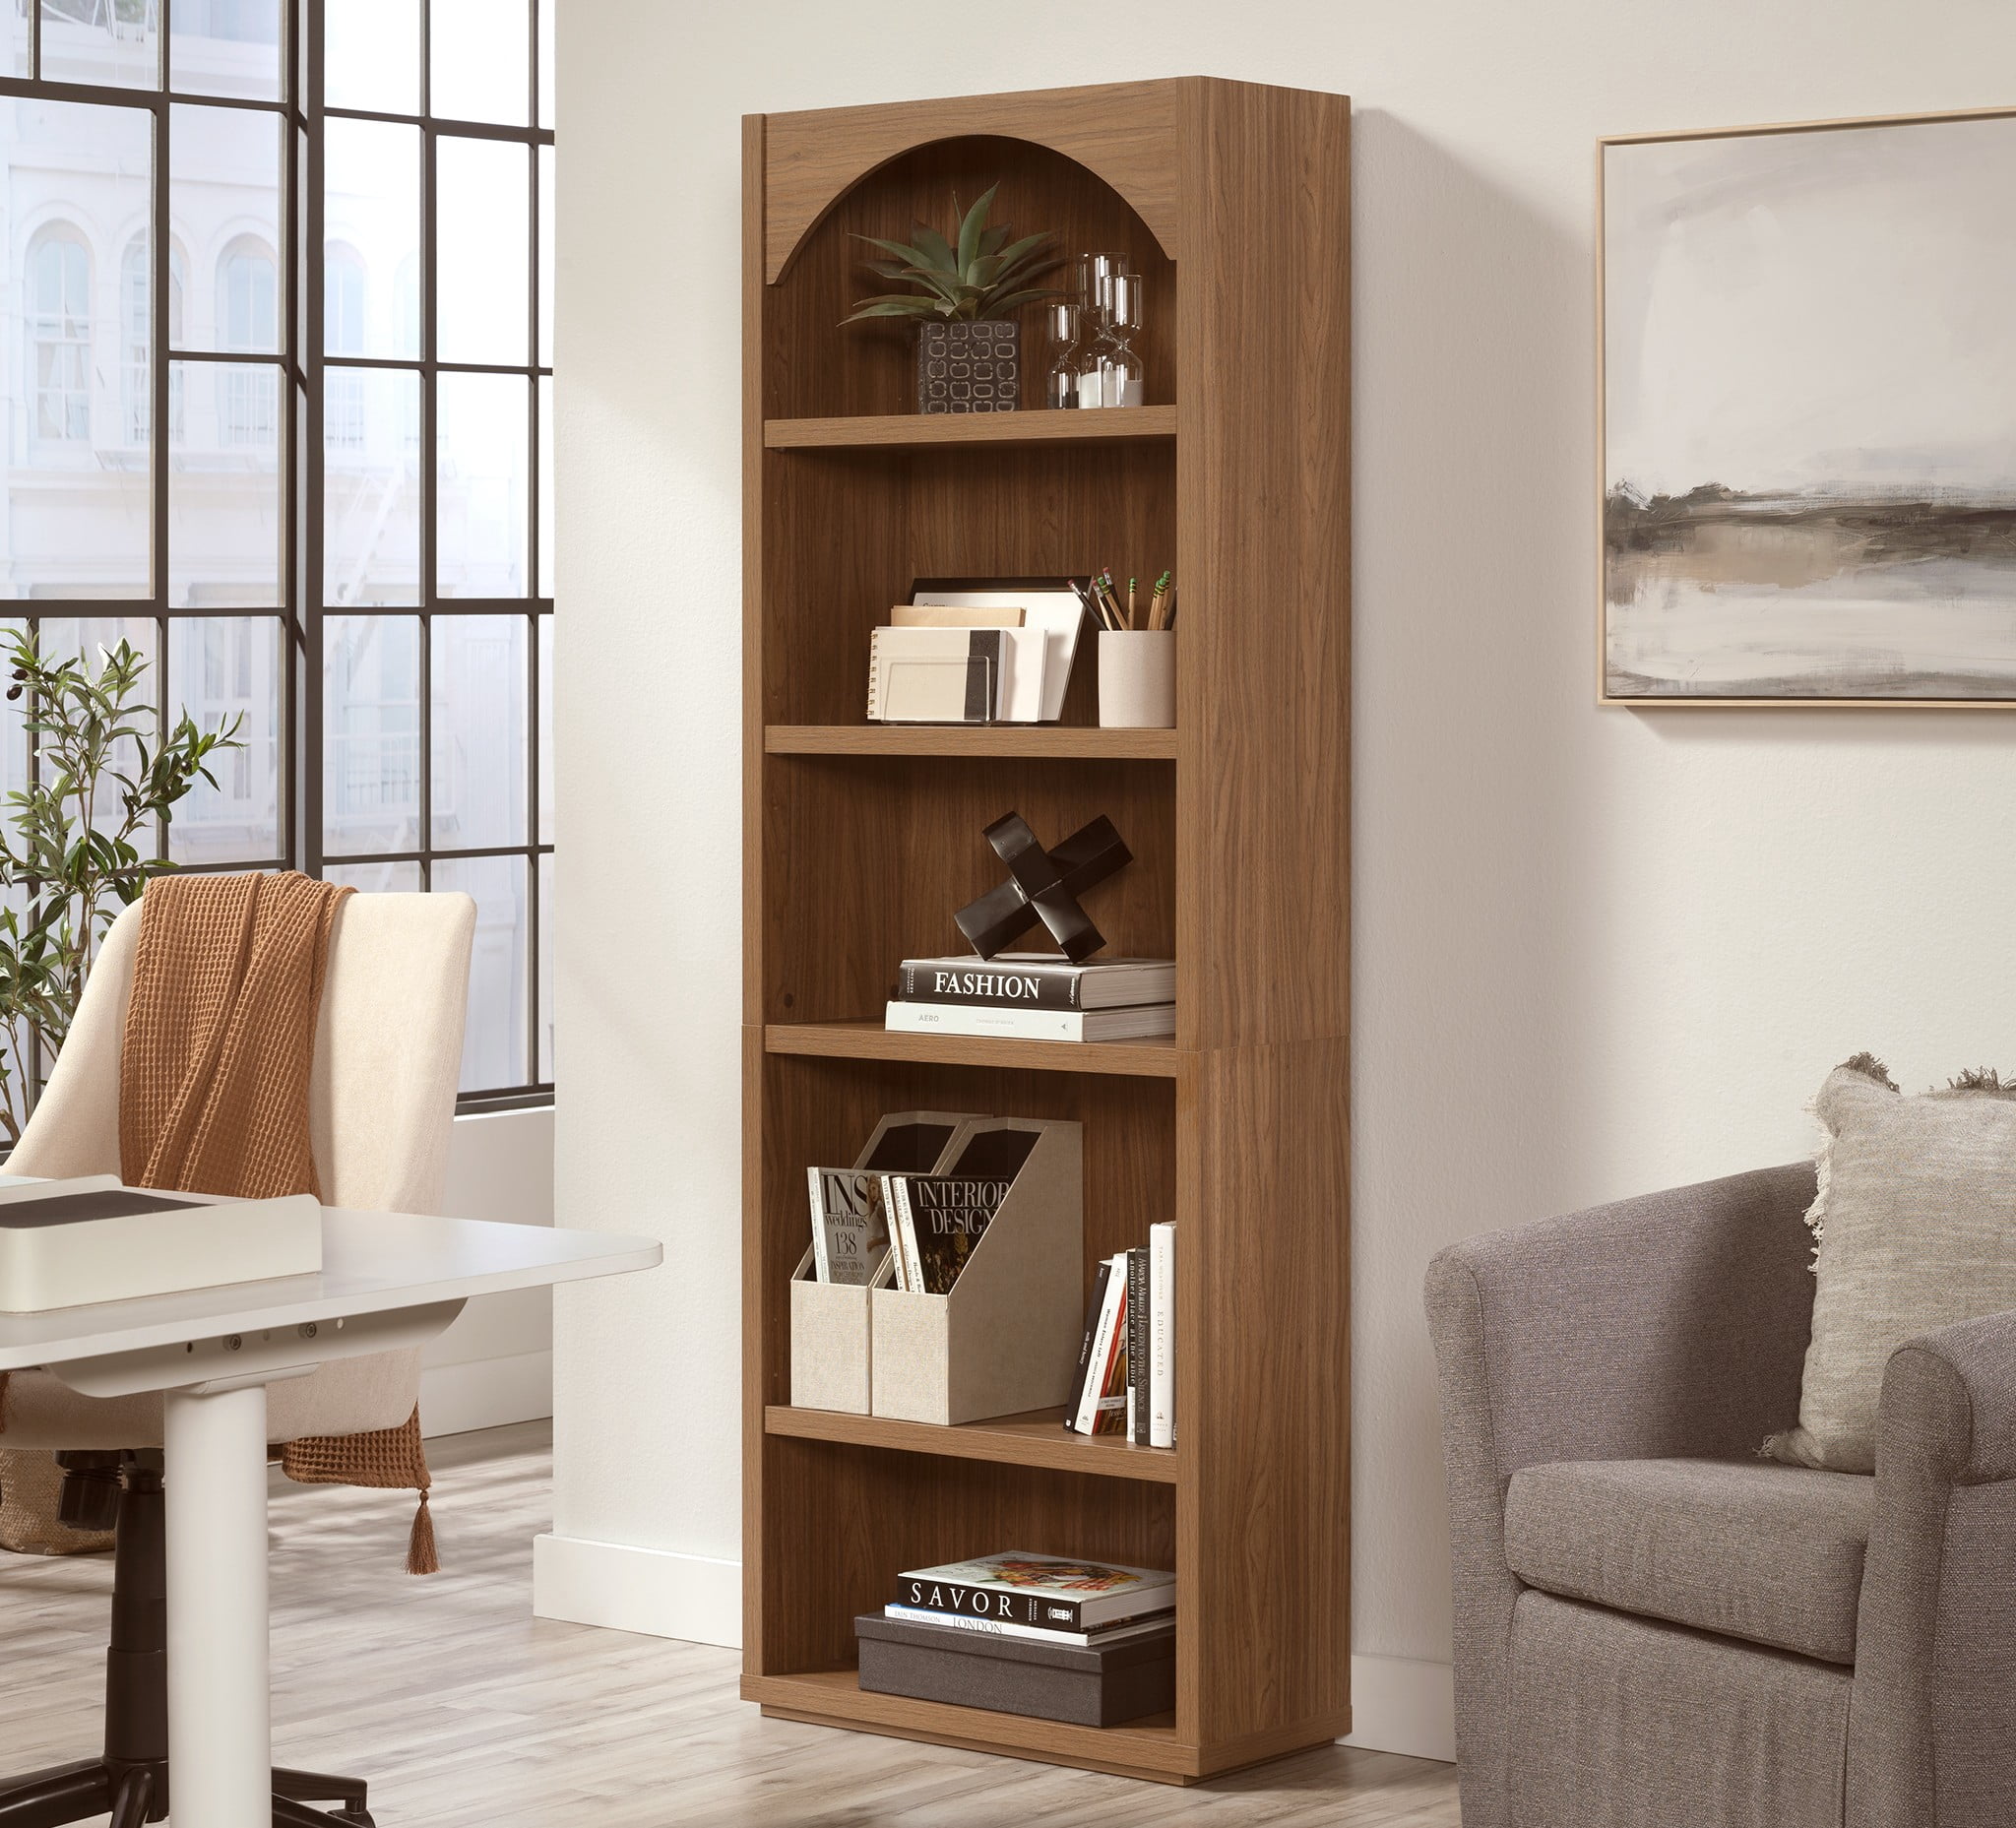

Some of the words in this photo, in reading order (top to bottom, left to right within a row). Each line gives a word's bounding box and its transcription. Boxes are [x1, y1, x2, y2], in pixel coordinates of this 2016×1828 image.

[933, 972, 1041, 999] FASHION
[825, 1210, 868, 1231] weddings
[834, 1231, 857, 1255] 138
[1138, 1377, 1148, 1412] SILENCE
[911, 1582, 1013, 1617] SAVOR
[909, 1611, 941, 1622] THOMSON
[953, 1616, 1002, 1634] LONDON
